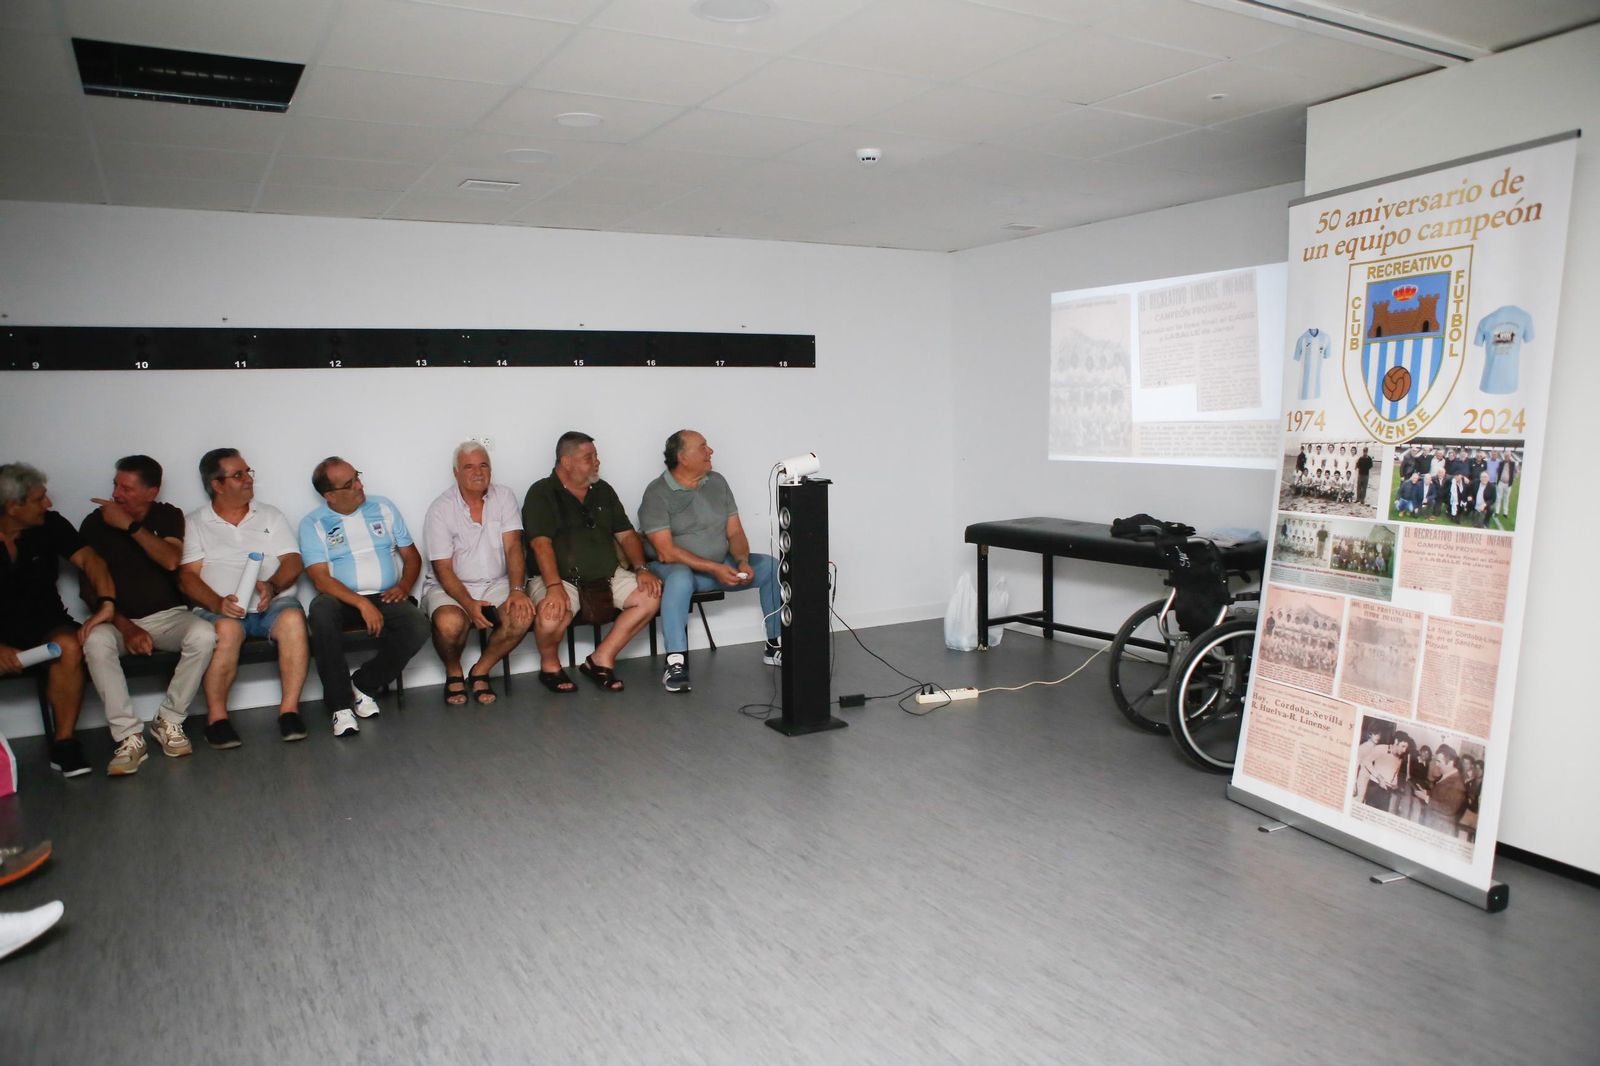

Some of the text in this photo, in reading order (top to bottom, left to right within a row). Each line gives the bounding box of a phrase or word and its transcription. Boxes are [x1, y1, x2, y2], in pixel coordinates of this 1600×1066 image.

[1315, 166, 1525, 234] 50 aniversario de
[1303, 196, 1543, 262] un equipo campeón
[1367, 253, 1453, 280] RECREATIVO
[1449, 269, 1465, 357] FUTBOL
[1350, 296, 1362, 352] CLUB
[32, 361, 40, 370] 9
[135, 361, 149, 369] 10
[234, 360, 247, 368] 11
[329, 360, 342, 368] 12
[415, 359, 428, 367] 13
[496, 359, 508, 367] 14
[573, 359, 585, 367] 15
[646, 359, 657, 367] 16
[1286, 408, 1326, 433] 1974
[1362, 407, 1431, 440] LINENSE
[1461, 407, 1526, 435] 2024
[1414, 528, 1452, 542] RECREATIVO
[1456, 531, 1482, 545] LINENSE
[1416, 541, 1497, 555] CAMPEÓN PROVINCIAL
[1300, 716, 1331, 731] Linense
